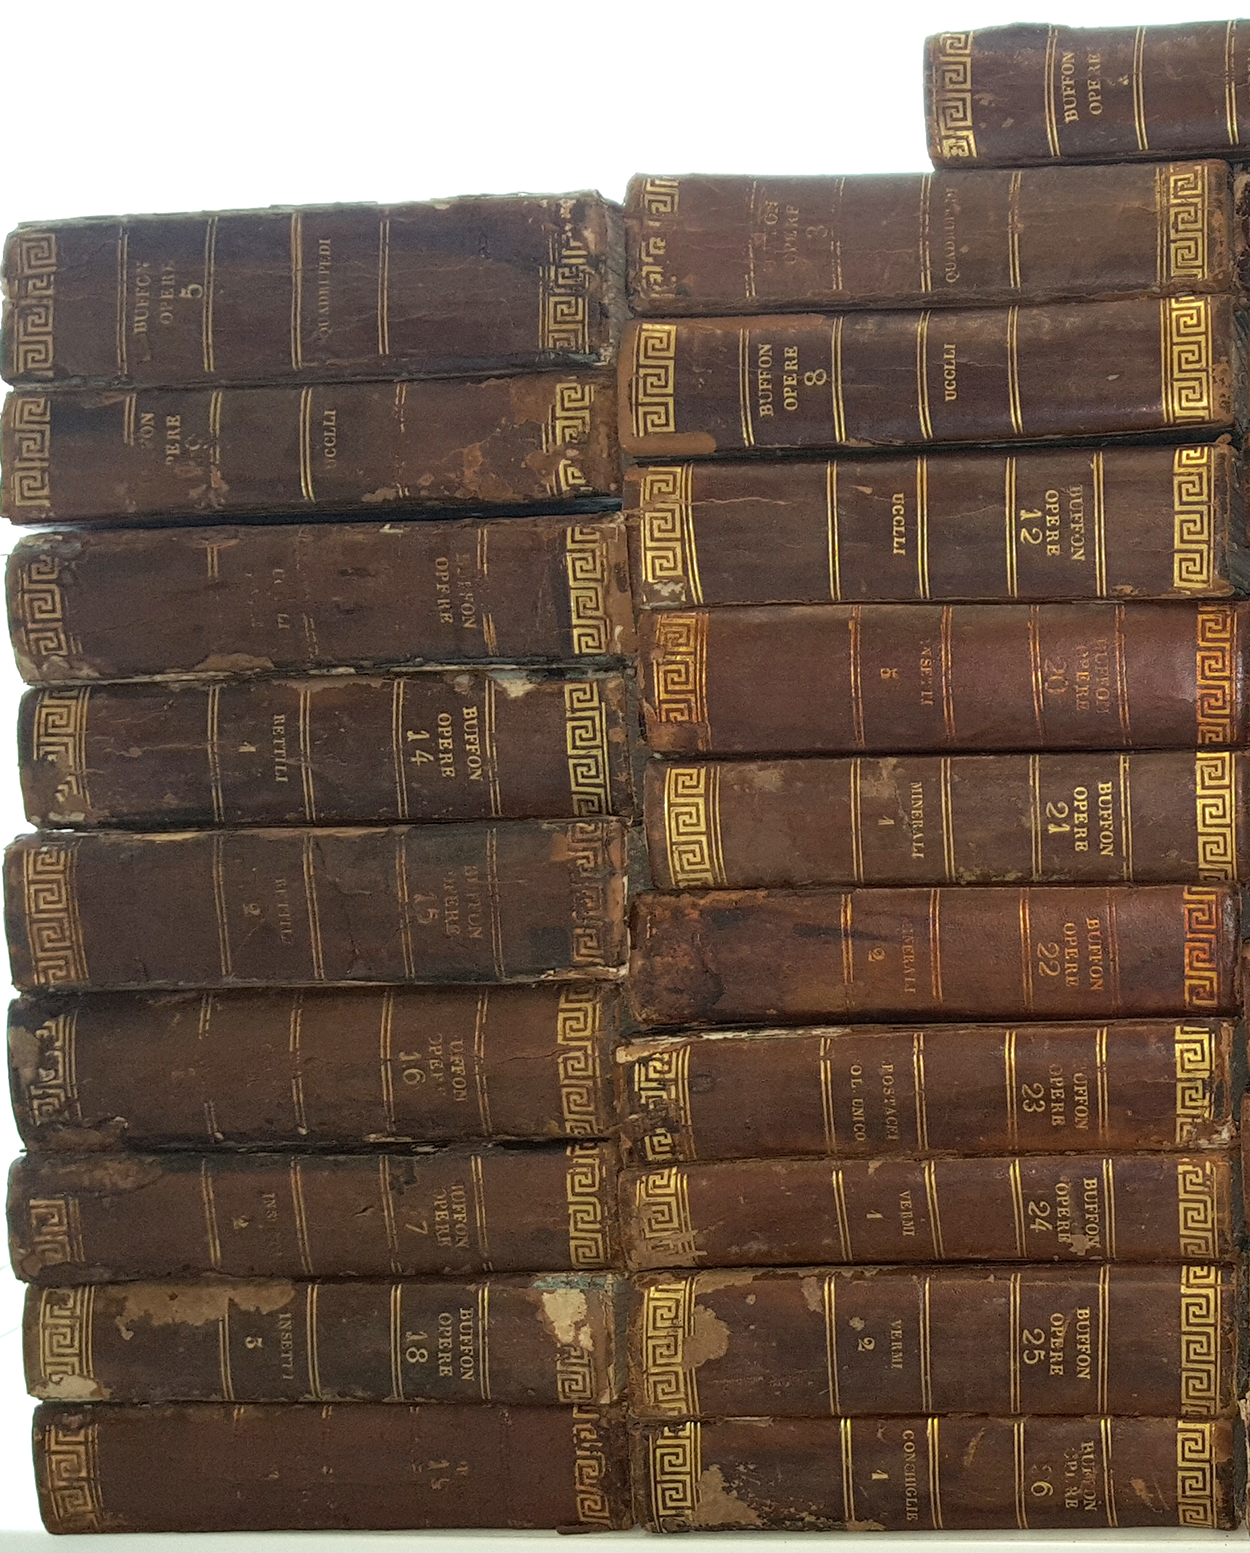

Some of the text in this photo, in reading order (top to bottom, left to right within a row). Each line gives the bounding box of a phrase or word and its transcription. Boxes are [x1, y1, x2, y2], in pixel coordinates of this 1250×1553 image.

[1061, 51, 1079, 124] BUFFON
[1088, 53, 1103, 115] OPERE
[180, 283, 203, 299] 5
[758, 344, 774, 417] BUFFON
[784, 346, 799, 411] OPERE
[804, 369, 827, 386] 8
[1020, 509, 1043, 545] 12
[1045, 489, 1060, 556] OPERE
[1069, 485, 1086, 561] BUFFON
[239, 741, 256, 752] 1
[273, 714, 288, 782] RETTILI
[407, 730, 434, 766] 14
[437, 713, 455, 778] OPERE
[462, 706, 483, 781] BUFFON
[877, 815, 895, 826] 1
[909, 781, 925, 858] MINERALI
[1046, 801, 1071, 835] 21
[1073, 786, 1088, 852] OPERE
[1098, 781, 1115, 857] BUFFON
[868, 948, 885, 963] 2
[1037, 941, 1061, 977] 22
[1063, 922, 1080, 988] OPERE
[1086, 917, 1104, 991] BUFFON
[852, 1097, 867, 1143] UNICO
[1022, 1083, 1045, 1113] 23
[866, 1210, 884, 1219] 1
[899, 1190, 916, 1237] VERMI
[1028, 1201, 1053, 1233] 24
[1055, 1183, 1071, 1243] OPERE
[1083, 1177, 1101, 1248] BUFFON
[245, 1335, 262, 1349] 3
[405, 1331, 428, 1363] 18
[438, 1313, 453, 1377] OPERE
[459, 1308, 475, 1381] BUFFON
[858, 1337, 875, 1352] 2
[890, 1319, 903, 1370] VERMI
[1023, 1328, 1045, 1364] 25
[1050, 1313, 1065, 1376] OPERE
[1076, 1306, 1091, 1380] BUFFON
[872, 1469, 889, 1480] 1
[902, 1430, 918, 1521] CONCHIGLIE
